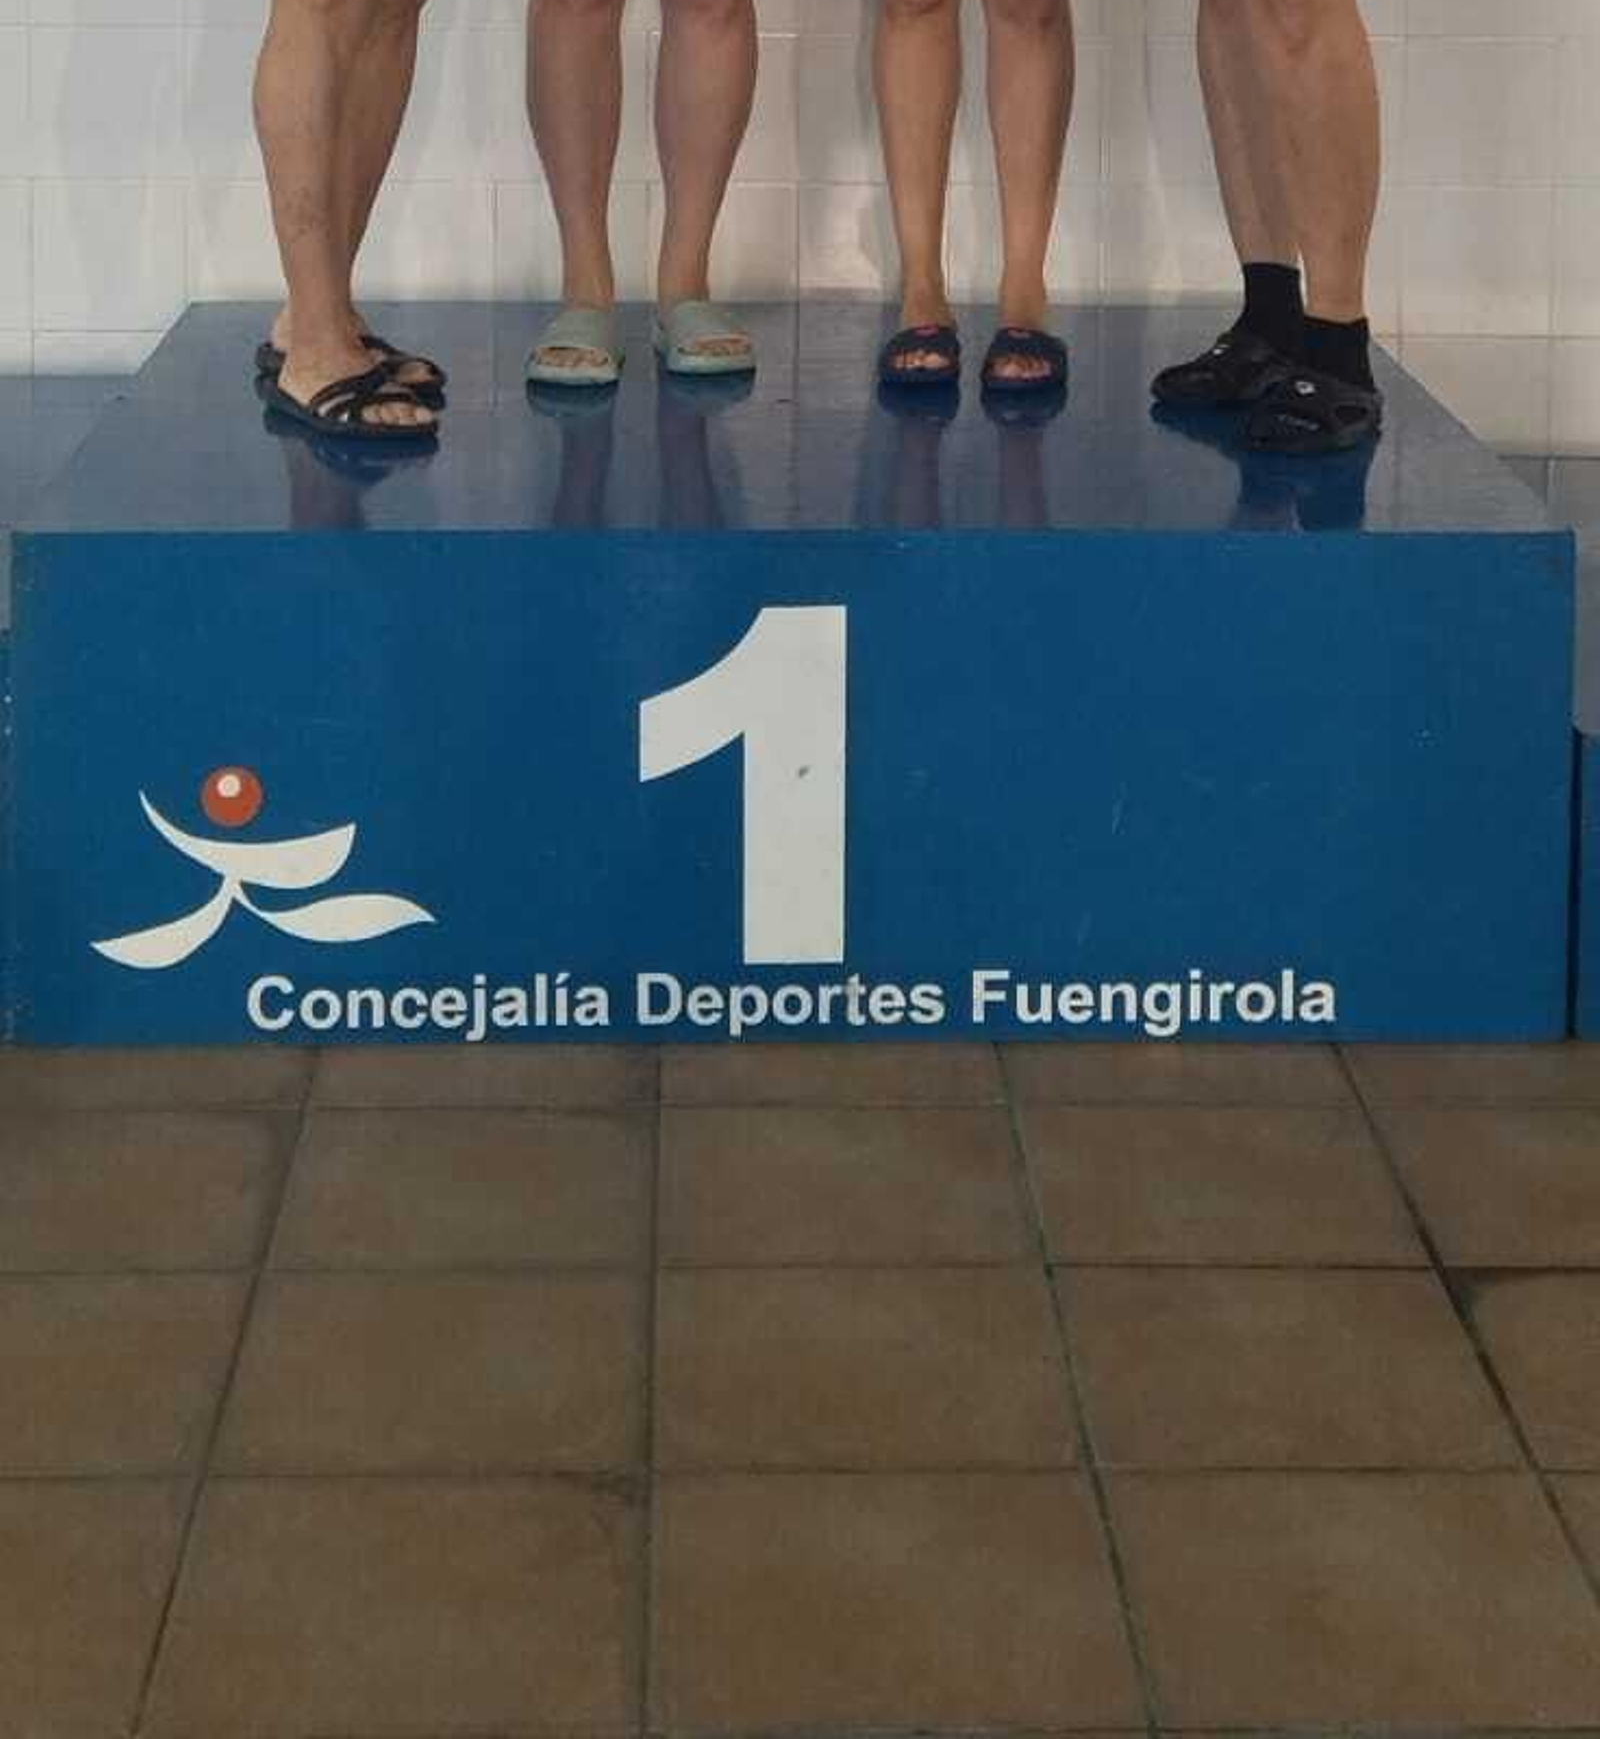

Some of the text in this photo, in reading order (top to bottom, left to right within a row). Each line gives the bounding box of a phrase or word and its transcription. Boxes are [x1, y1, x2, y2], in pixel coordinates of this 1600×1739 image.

[640, 605, 847, 964] 1
[246, 969, 1337, 1042] Concejalía Deportes Fuengirola
